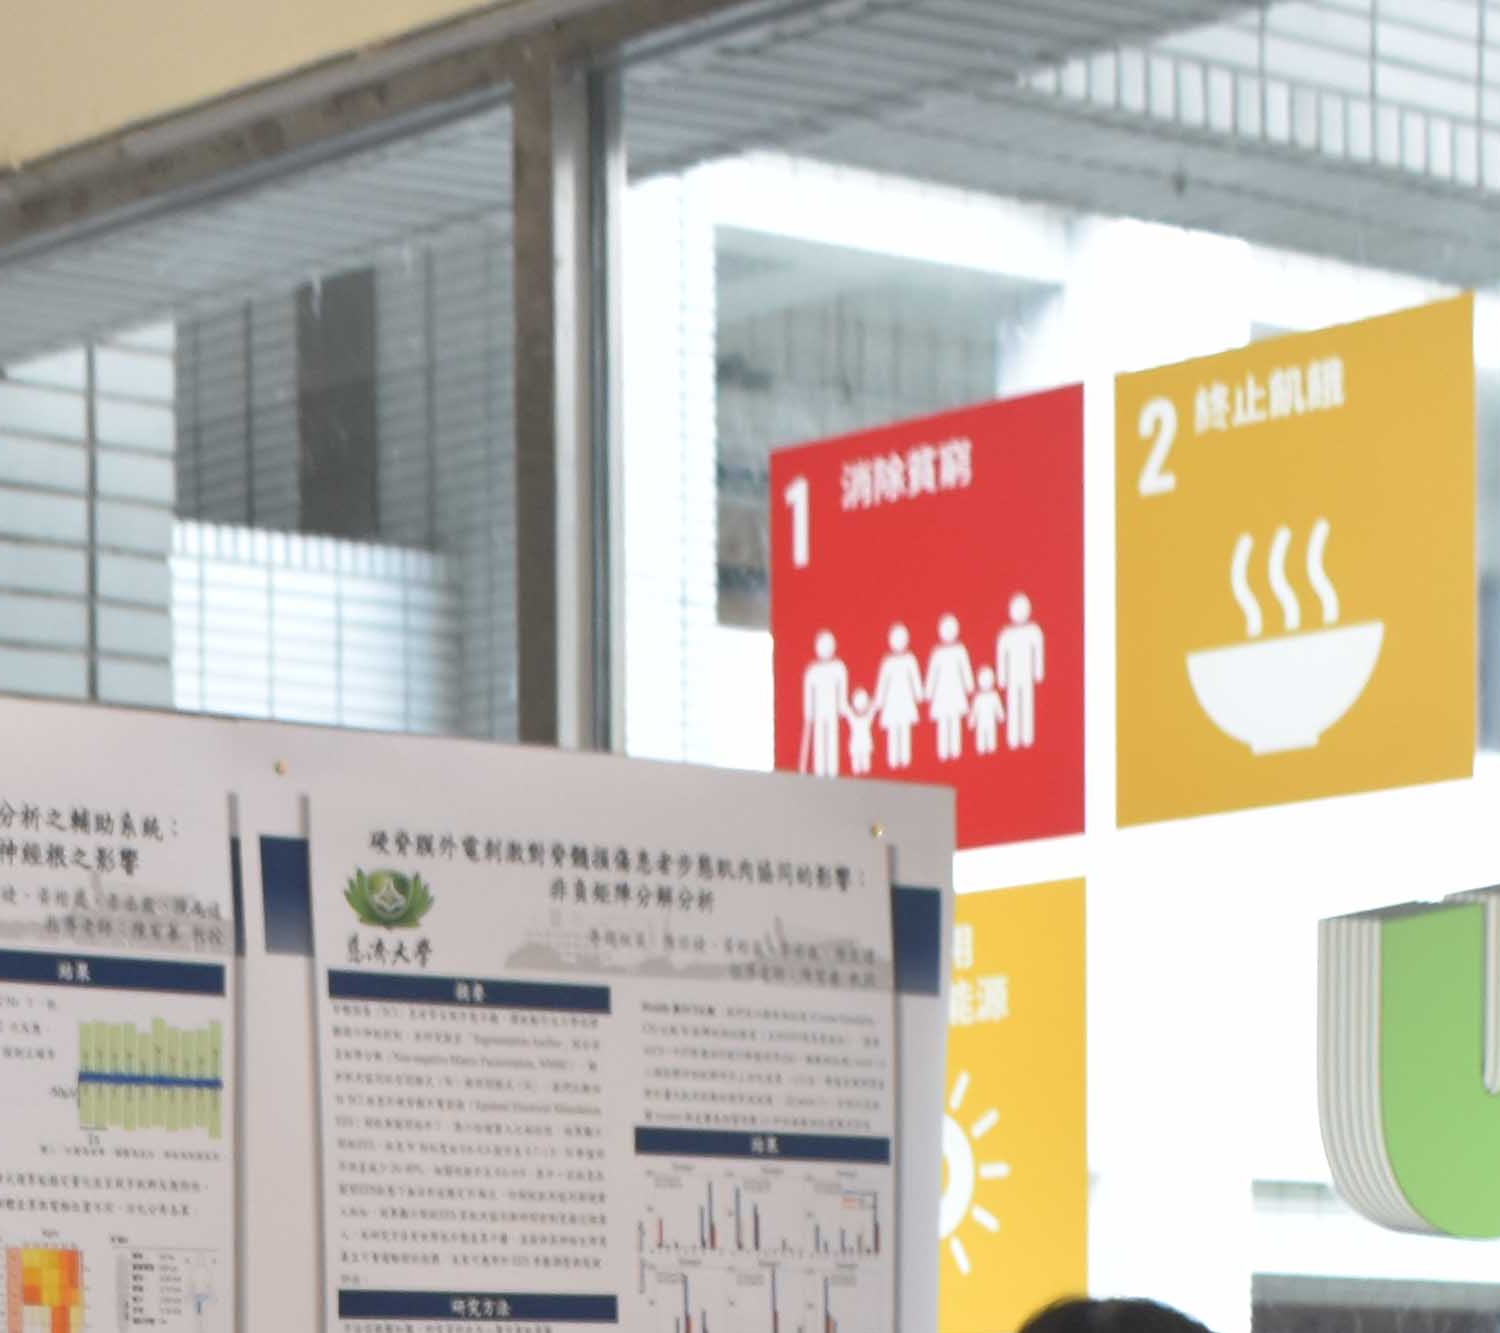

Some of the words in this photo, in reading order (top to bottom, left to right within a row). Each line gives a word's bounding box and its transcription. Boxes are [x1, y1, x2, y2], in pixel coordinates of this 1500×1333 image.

[1192, 356, 1345, 434] 終止飢餓
[840, 439, 974, 509] 消除貧窮
[1137, 397, 1178, 496] 2
[782, 476, 811, 567] 1
